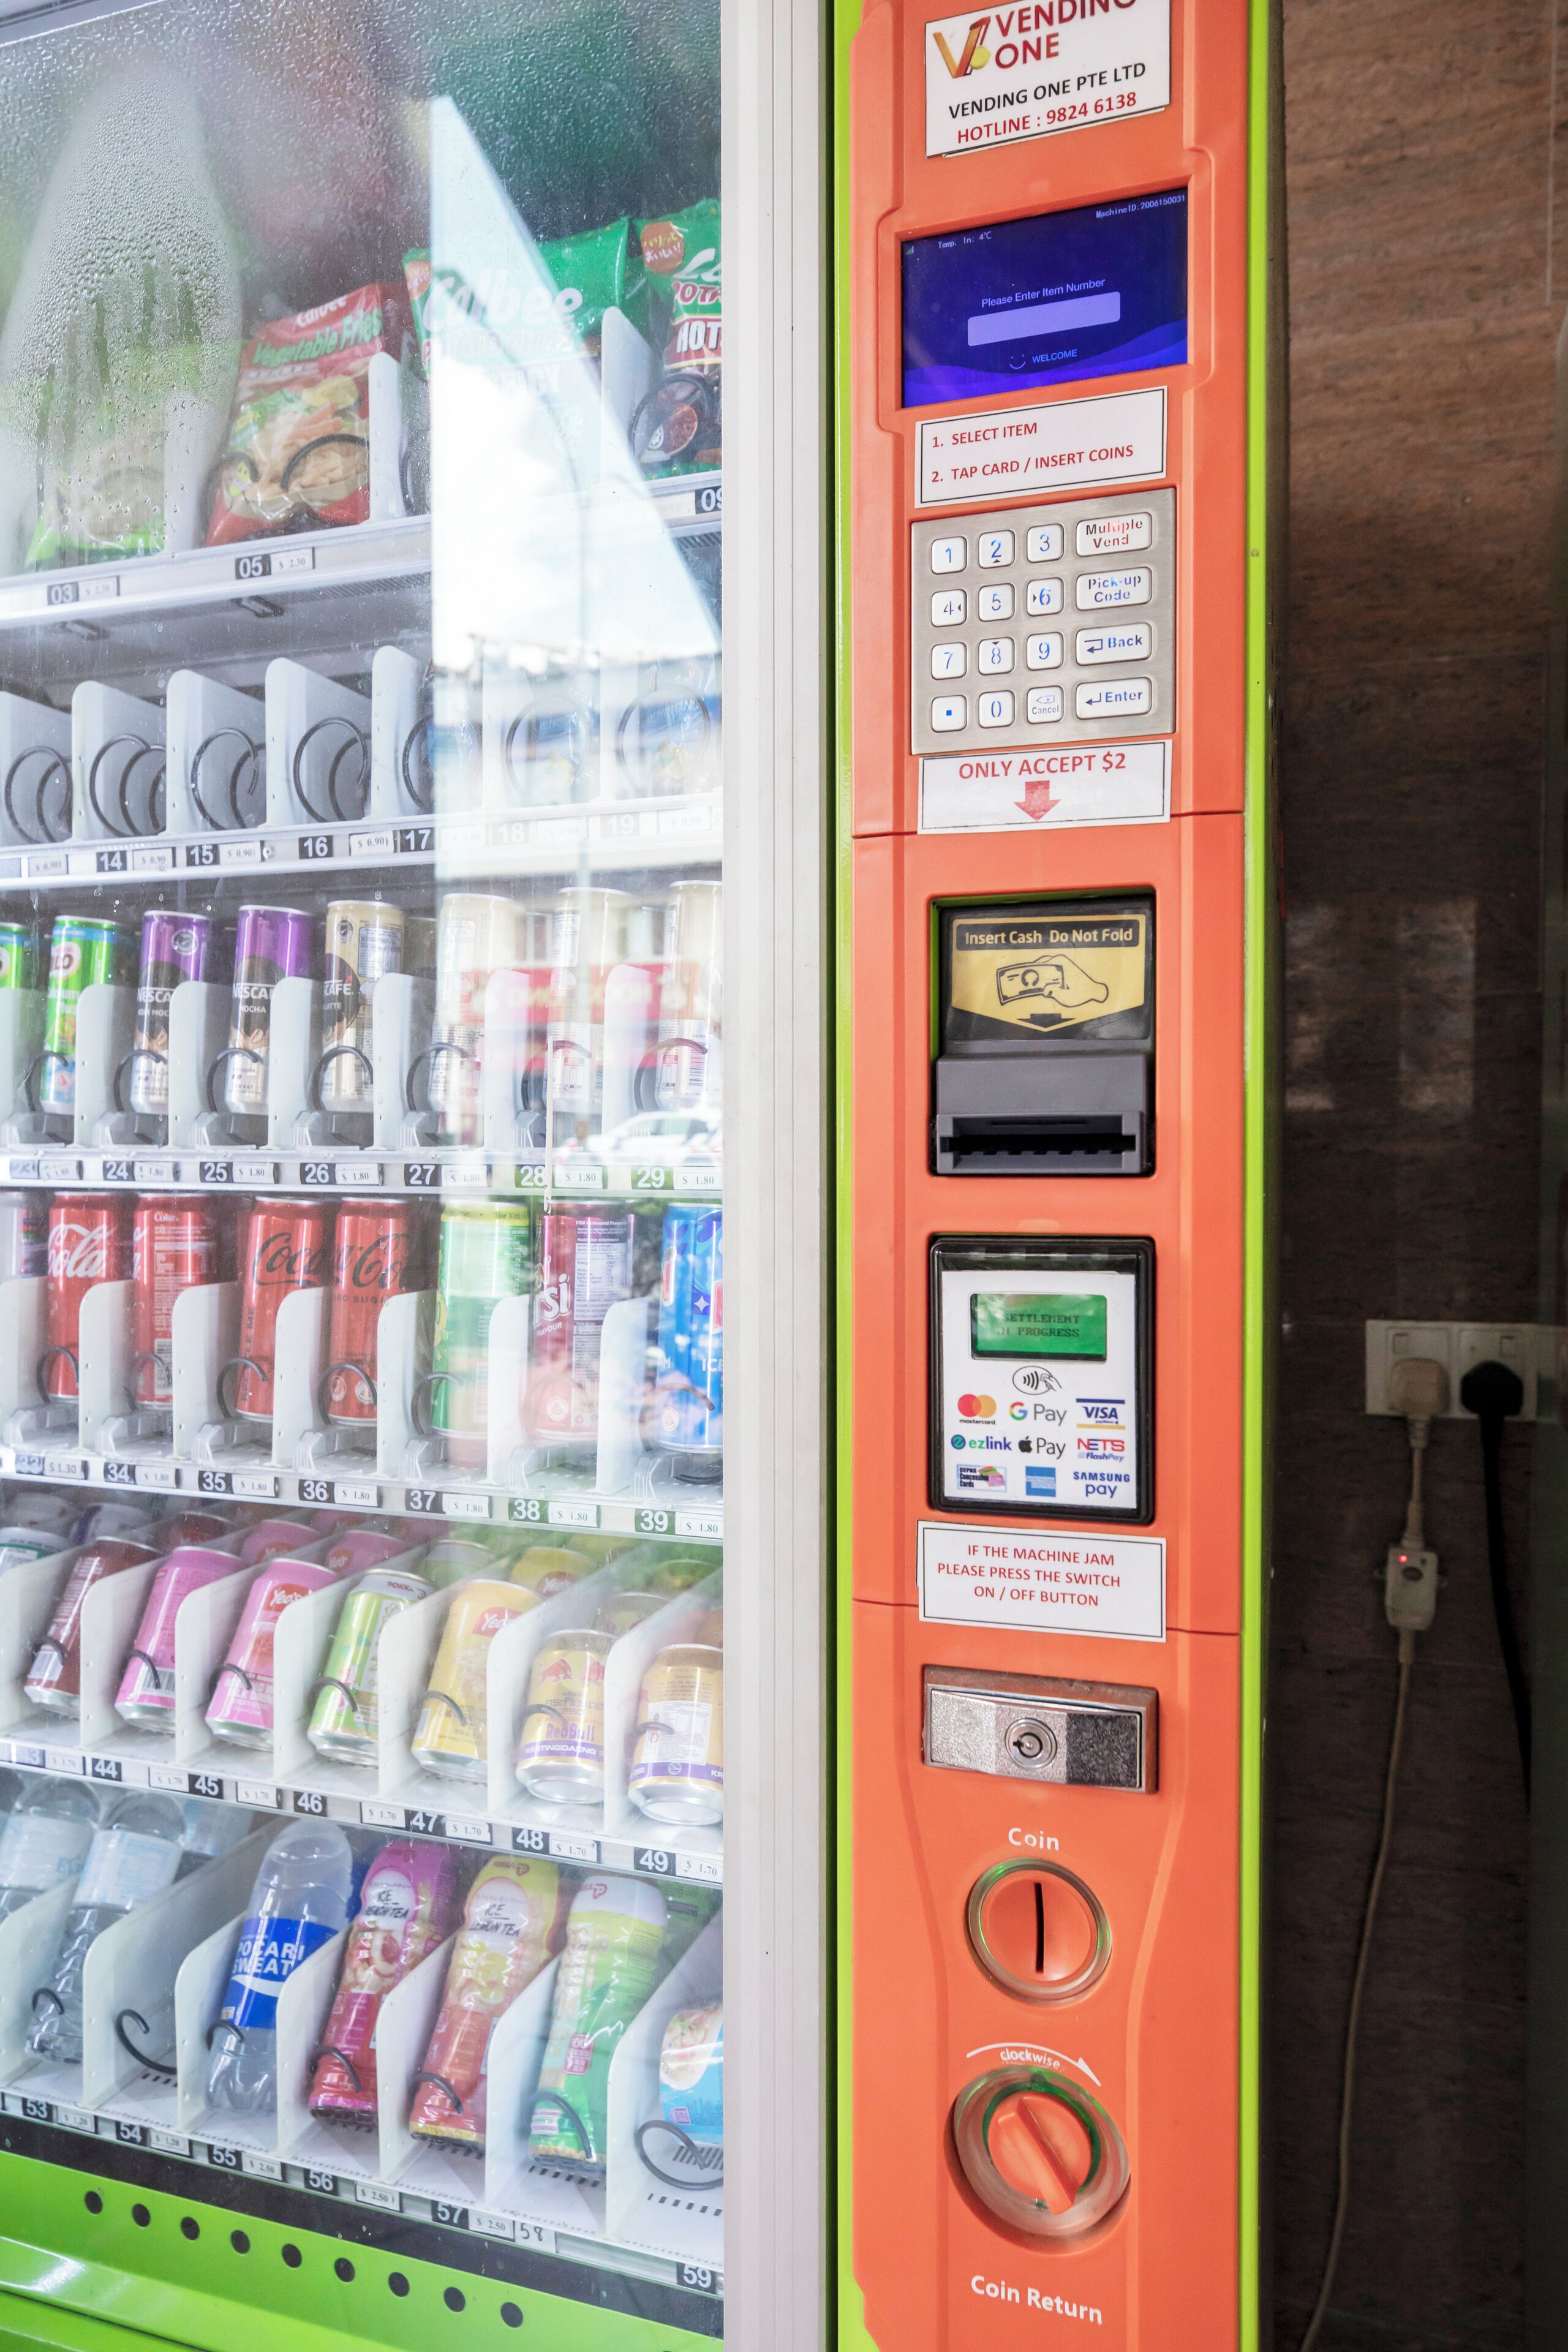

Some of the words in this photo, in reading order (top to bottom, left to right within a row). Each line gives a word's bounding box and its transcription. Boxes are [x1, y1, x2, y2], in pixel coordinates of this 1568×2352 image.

[995, 32, 1059, 69] ONE
[949, 89, 1027, 119] VENDING
[1034, 80, 1070, 100] ONE
[1077, 70, 1107, 91] PTE
[1114, 62, 1145, 82] LTD
[958, 115, 1030, 144] HOTLINE
[1047, 102, 1088, 124] 9824
[1095, 92, 1137, 113] 6138
[938, 240, 957, 249] Temp.
[982, 295, 1012, 307] Please
[1015, 290, 1040, 302] Enter
[1042, 286, 1063, 297] Item
[1066, 279, 1106, 293] Number
[1033, 349, 1077, 363] WELCOME
[932, 436, 944, 448] 1.
[952, 428, 999, 445] SELECT
[1003, 423, 1038, 438] ITEM
[932, 471, 943, 483] 2.
[952, 467, 977, 480] TAP
[982, 461, 1020, 476] CARD
[1023, 457, 1030, 473] /
[1035, 451, 1085, 469] INSERT
[1089, 445, 1133, 462] COINS
[1086, 519, 1143, 535] Multiple
[990, 540, 1002, 558] 2
[1039, 533, 1050, 552] 3
[1093, 535, 1129, 549] Vend
[946, 545, 952, 564] 1
[238, 556, 263, 577] 05
[1088, 575, 1141, 590] Pick-up
[992, 592, 1001, 611] 5
[1039, 587, 1051, 606] 6
[1094, 590, 1130, 603] Code
[943, 601, 954, 616] 4
[1039, 641, 1050, 660] 9
[1108, 635, 1142, 648] Back
[944, 651, 954, 669] 7
[992, 647, 1001, 665] 8
[1105, 690, 1143, 703] Enter
[991, 700, 1002, 718] 0
[1032, 705, 1059, 715] Cancel
[959, 760, 1013, 780] ONLY
[1018, 755, 1096, 775] ACCEPT
[1102, 751, 1126, 772] $2
[498, 821, 524, 844] 18
[607, 813, 634, 835] 19
[303, 836, 328, 858] 16
[405, 829, 431, 851] 17
[99, 852, 123, 872] 14
[190, 845, 214, 865] 15
[965, 932, 1006, 945] Insert
[1009, 930, 1042, 944] Cash
[1049, 930, 1068, 943] Do
[1072, 929, 1098, 942] Not
[1102, 929, 1133, 941] Fold
[233, 986, 276, 1000] NESCA
[105, 1161, 129, 1180] 24
[203, 1162, 228, 1182] 25
[304, 1163, 330, 1183] 26
[408, 1164, 436, 1185] 27
[520, 1165, 546, 1187] 28
[578, 1172, 597, 1182] 1.80
[636, 1166, 665, 1189] 29
[695, 1175, 715, 1185] 1.80
[1003, 1313, 1080, 1324] SETTLEMENT
[537, 1322, 562, 1337] FLAVOUR
[1018, 1327, 1080, 1337] PROGRESS
[1009, 1402, 1028, 1421] G
[1033, 1404, 1067, 1426] Pay
[1082, 1406, 1118, 1419] VISA
[968, 1436, 1012, 1451] ezlink
[1036, 1438, 1066, 1459] Pay
[1077, 1438, 1125, 1452] NETS
[1086, 1452, 1125, 1463] FlashPay
[107, 1463, 130, 1483] 34
[202, 1471, 227, 1492] 35
[1074, 1471, 1130, 1482] SAMSUNG
[303, 1480, 328, 1501] 36
[353, 1491, 370, 1501] 1.80
[1085, 1484, 1117, 1498] pay
[409, 1490, 437, 1512] 37
[513, 1498, 541, 1521] 38
[570, 1512, 588, 1522] 1.80
[640, 1509, 669, 1532] 39
[698, 1522, 718, 1534] 1.80
[968, 1545, 979, 1556] IF
[983, 1545, 1009, 1558] THE
[1014, 1548, 1080, 1563] MACHINE
[1084, 1553, 1115, 1566] JAM
[938, 1563, 985, 1577] PLEASE
[990, 1567, 1030, 1580] PRESS
[1035, 1570, 1060, 1583] THE
[1065, 1572, 1120, 1587] SWITCH
[974, 1586, 994, 1598] ON
[1000, 1587, 1005, 1600] /
[1010, 1589, 1035, 1601] OFF
[1041, 1591, 1098, 1606] BUTTON
[94, 1759, 118, 1779] 44
[194, 1775, 219, 1796] 45
[297, 1792, 323, 1814] 46
[410, 1811, 439, 1832] 47
[516, 1828, 545, 1851] 48
[1008, 1827, 1059, 1850] Coin
[639, 1849, 669, 1872] 49
[484, 1903, 505, 1917] ICE
[499, 1921, 521, 1937] TEA
[236, 1940, 304, 1962] POCARI
[232, 1956, 295, 1977] SWEAT
[1000, 2047, 1061, 2070] clockwise
[26, 2098, 48, 2119] 53
[119, 2122, 142, 2143] 54
[213, 2147, 236, 2167] 55
[309, 2169, 334, 2192] 56
[437, 2201, 464, 2224] 57
[684, 2264, 711, 2288] 59
[971, 2275, 1019, 2303] Coin
[1027, 2288, 1102, 2326] Return
